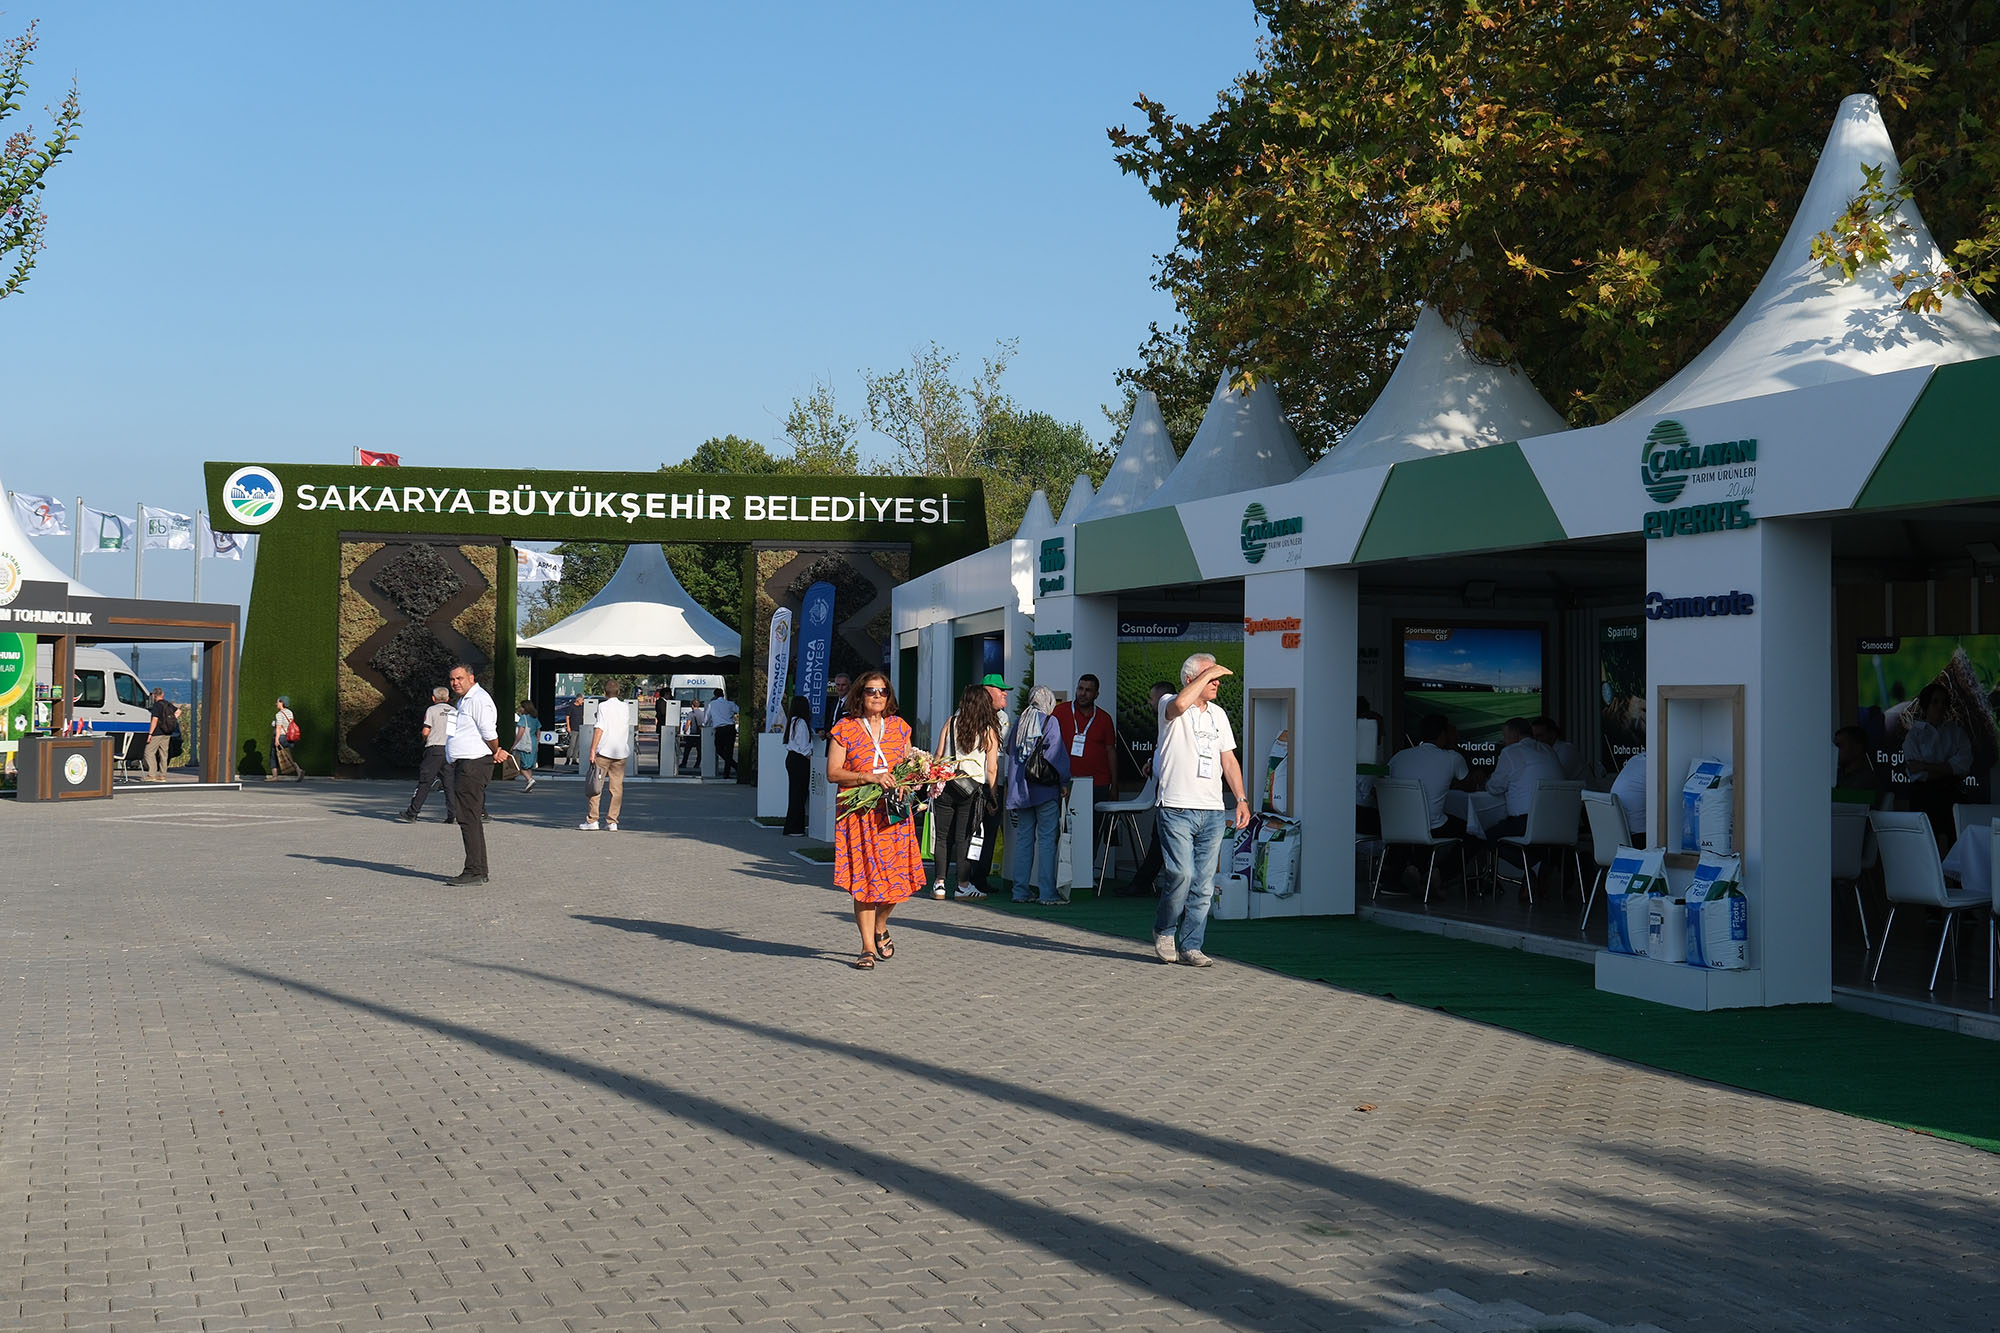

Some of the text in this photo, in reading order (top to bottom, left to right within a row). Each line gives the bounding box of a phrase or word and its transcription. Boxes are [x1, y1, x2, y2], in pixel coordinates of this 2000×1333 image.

[1649, 438, 1757, 479] ÇAĞLAYAN
[1692, 463, 1757, 484] TARIM ÜRÜNLERİ
[296, 484, 950, 524] SAKARYA BÜYÜKŞEHİR BELEDİYESİ
[1645, 590, 1754, 620] Osmocote
[12, 609, 93, 625] TOHUMCULUK
[1121, 622, 1178, 634] Osmoform
[1607, 625, 1638, 640] Sparring
[1861, 640, 1894, 650] Osmocote
[803, 639, 817, 700] APANCA
[1613, 744, 1631, 755] Daha
[1876, 750, 1889, 763] En
